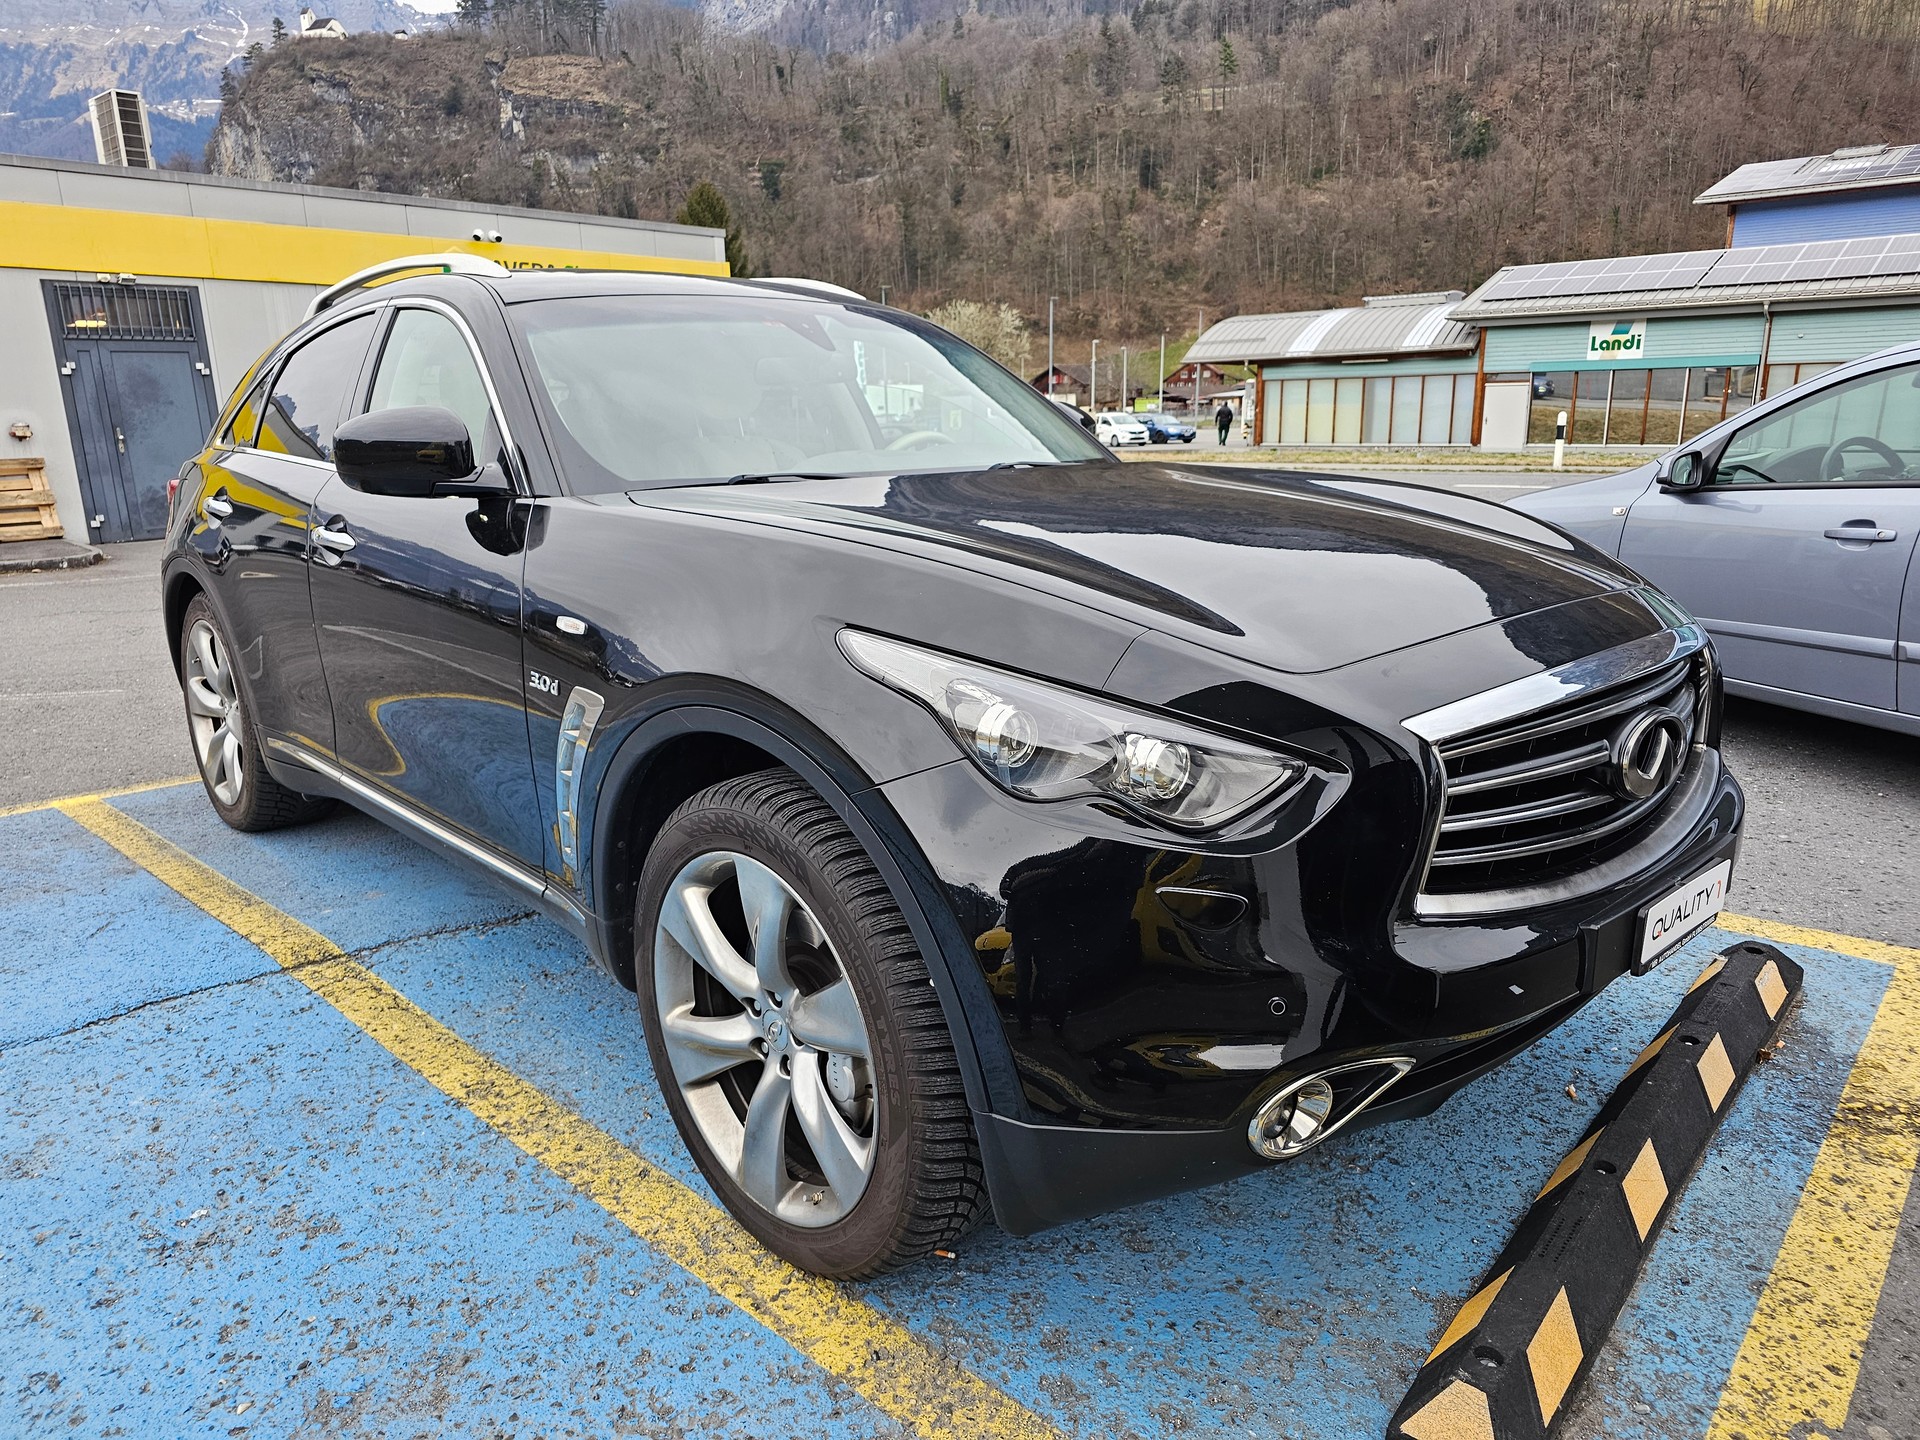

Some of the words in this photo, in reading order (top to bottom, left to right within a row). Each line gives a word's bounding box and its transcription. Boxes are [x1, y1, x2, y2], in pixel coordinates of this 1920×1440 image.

[1590, 334, 1642, 352] Landi
[1651, 883, 1715, 941] QUALITY
[1716, 879, 1722, 899] 1
[876, 1015, 900, 1105] TYRES
